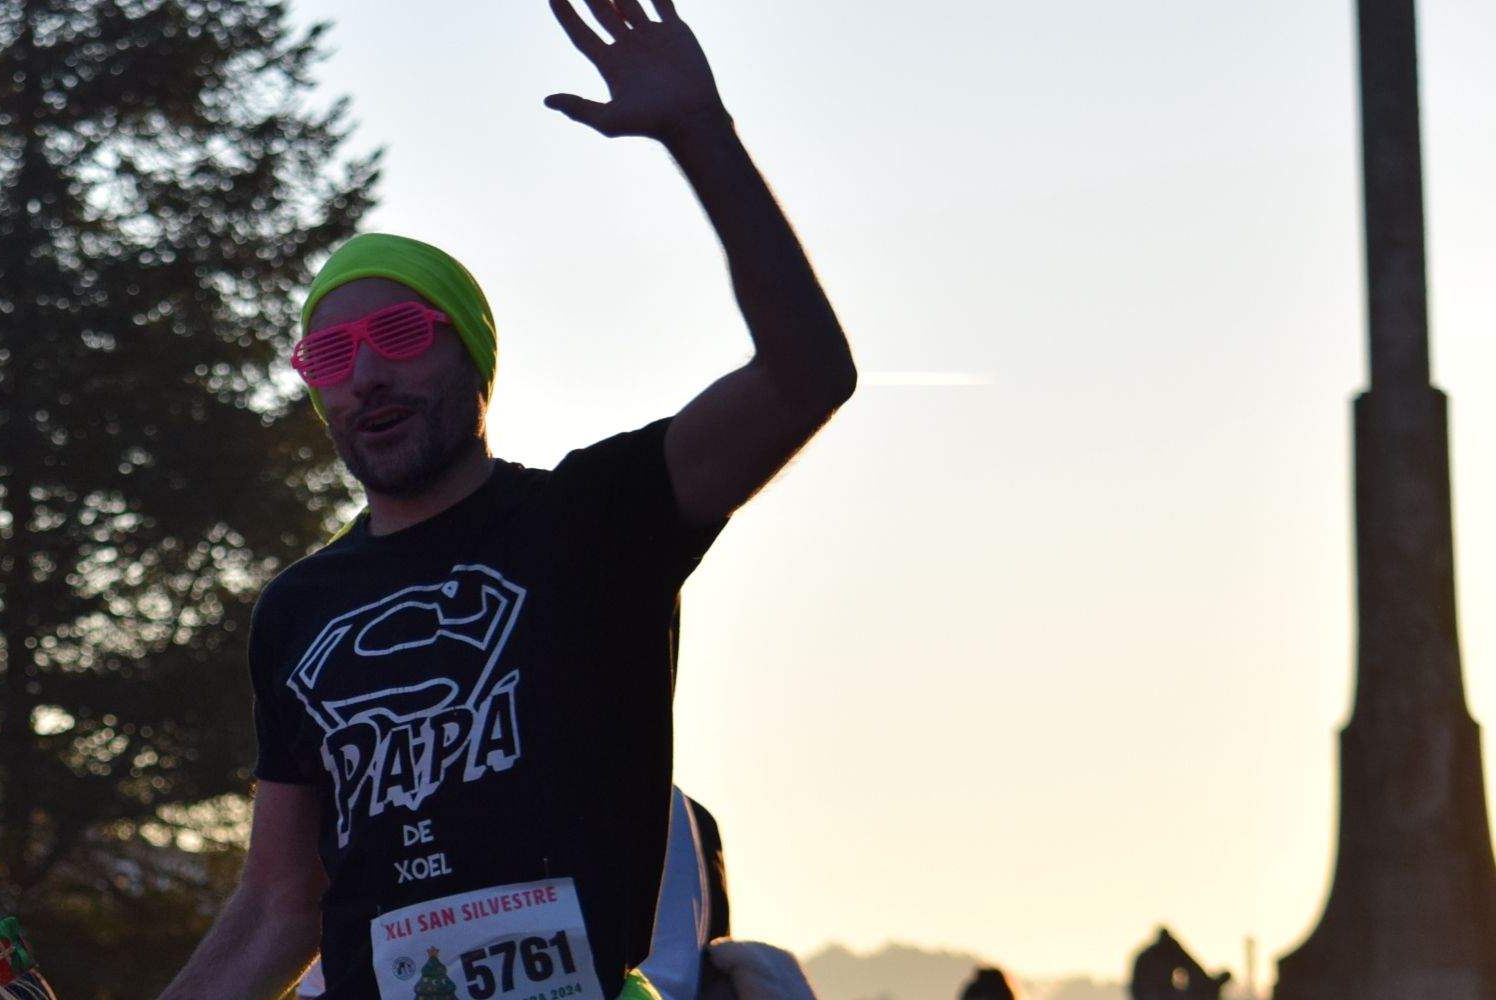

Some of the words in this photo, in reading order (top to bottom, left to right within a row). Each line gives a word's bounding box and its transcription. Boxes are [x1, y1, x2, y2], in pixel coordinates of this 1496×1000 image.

[321, 669, 521, 848] PAPA
[404, 819, 434, 846] DE
[394, 853, 452, 884] XOEL
[384, 917, 412, 941] XLI
[417, 907, 456, 932] SAN
[462, 886, 558, 922] SILVESTRE
[460, 930, 577, 1000] 5761
[551, 982, 583, 1000] 2024
